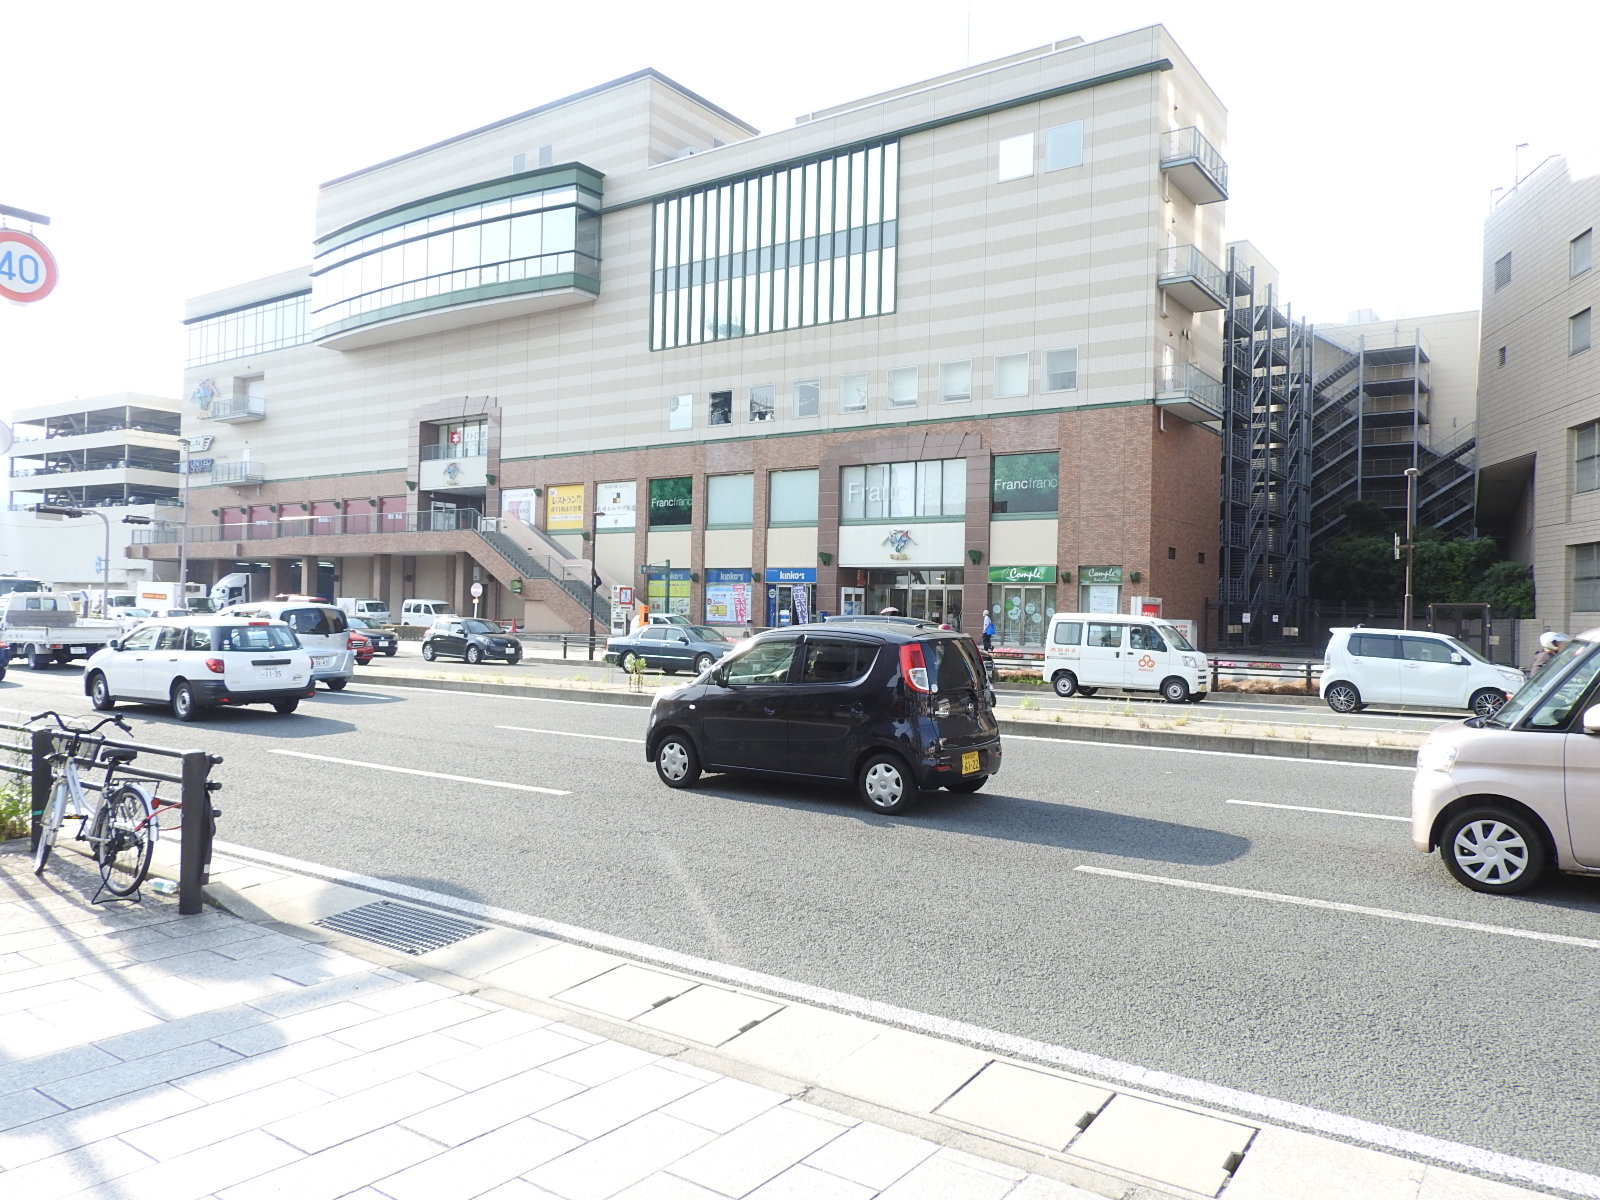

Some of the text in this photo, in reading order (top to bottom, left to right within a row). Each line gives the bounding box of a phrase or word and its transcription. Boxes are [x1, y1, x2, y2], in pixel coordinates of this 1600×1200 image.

[0, 249, 39, 285] 40
[994, 476, 1058, 491] Francfranc
[651, 496, 692, 507] Francfranc
[720, 571, 744, 580] kinko's
[780, 571, 805, 580] kinko's
[964, 760, 979, 772] 61-22
